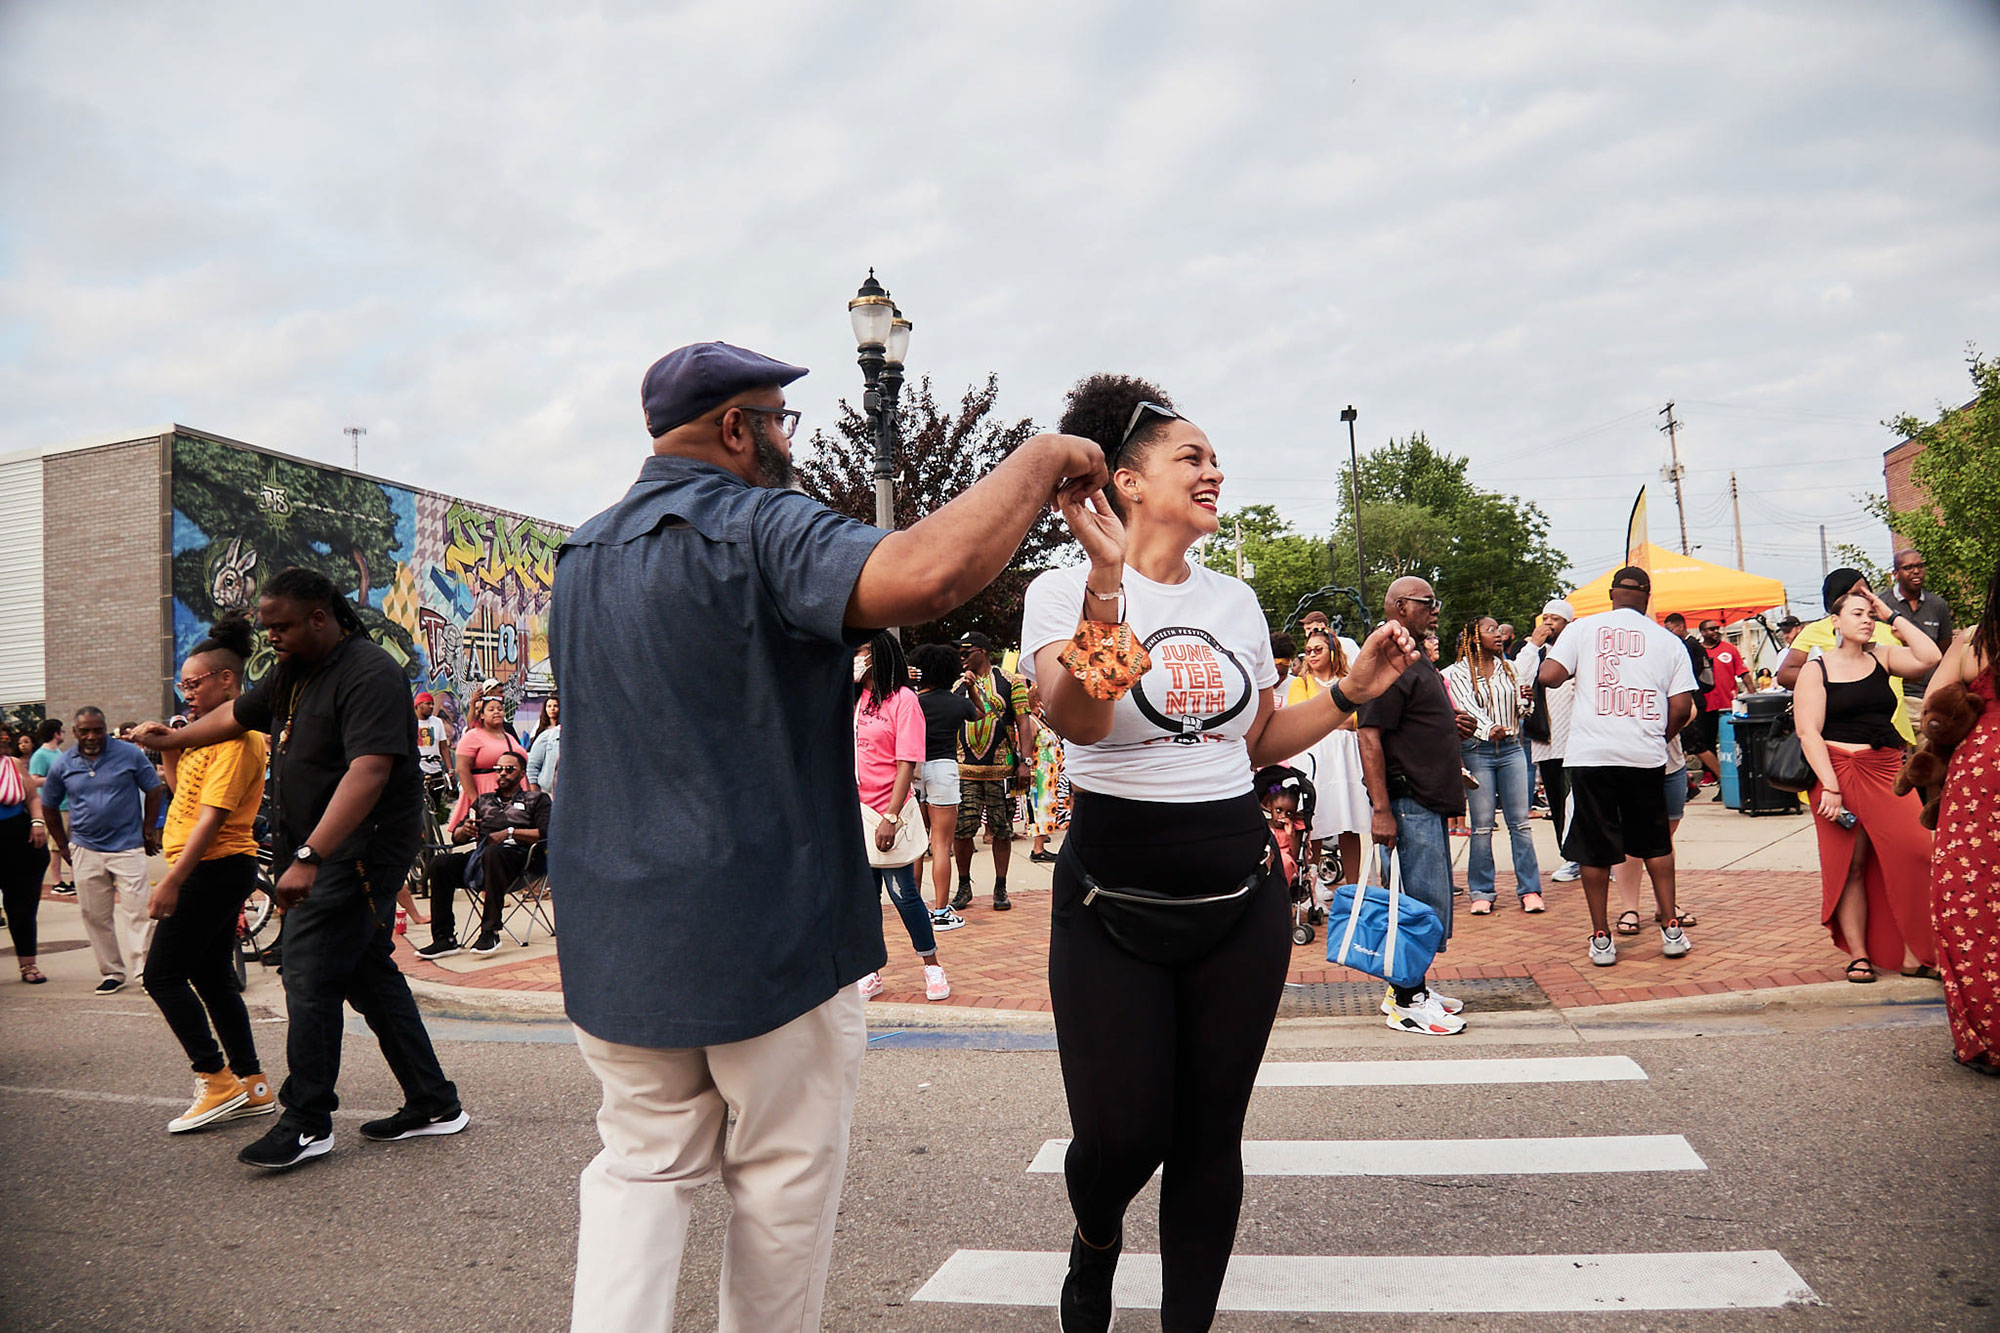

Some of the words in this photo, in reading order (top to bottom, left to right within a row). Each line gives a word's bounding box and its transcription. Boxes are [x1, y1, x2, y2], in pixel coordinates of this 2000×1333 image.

[1178, 629, 1211, 642] FESTIVAL
[1595, 626, 1646, 657] GOD
[1162, 644, 1216, 661] JUNE
[1164, 662, 1224, 689] TEE
[1595, 655, 1620, 685] IS
[1165, 690, 1226, 715] NTH
[1595, 685, 1661, 720] DOPE.
